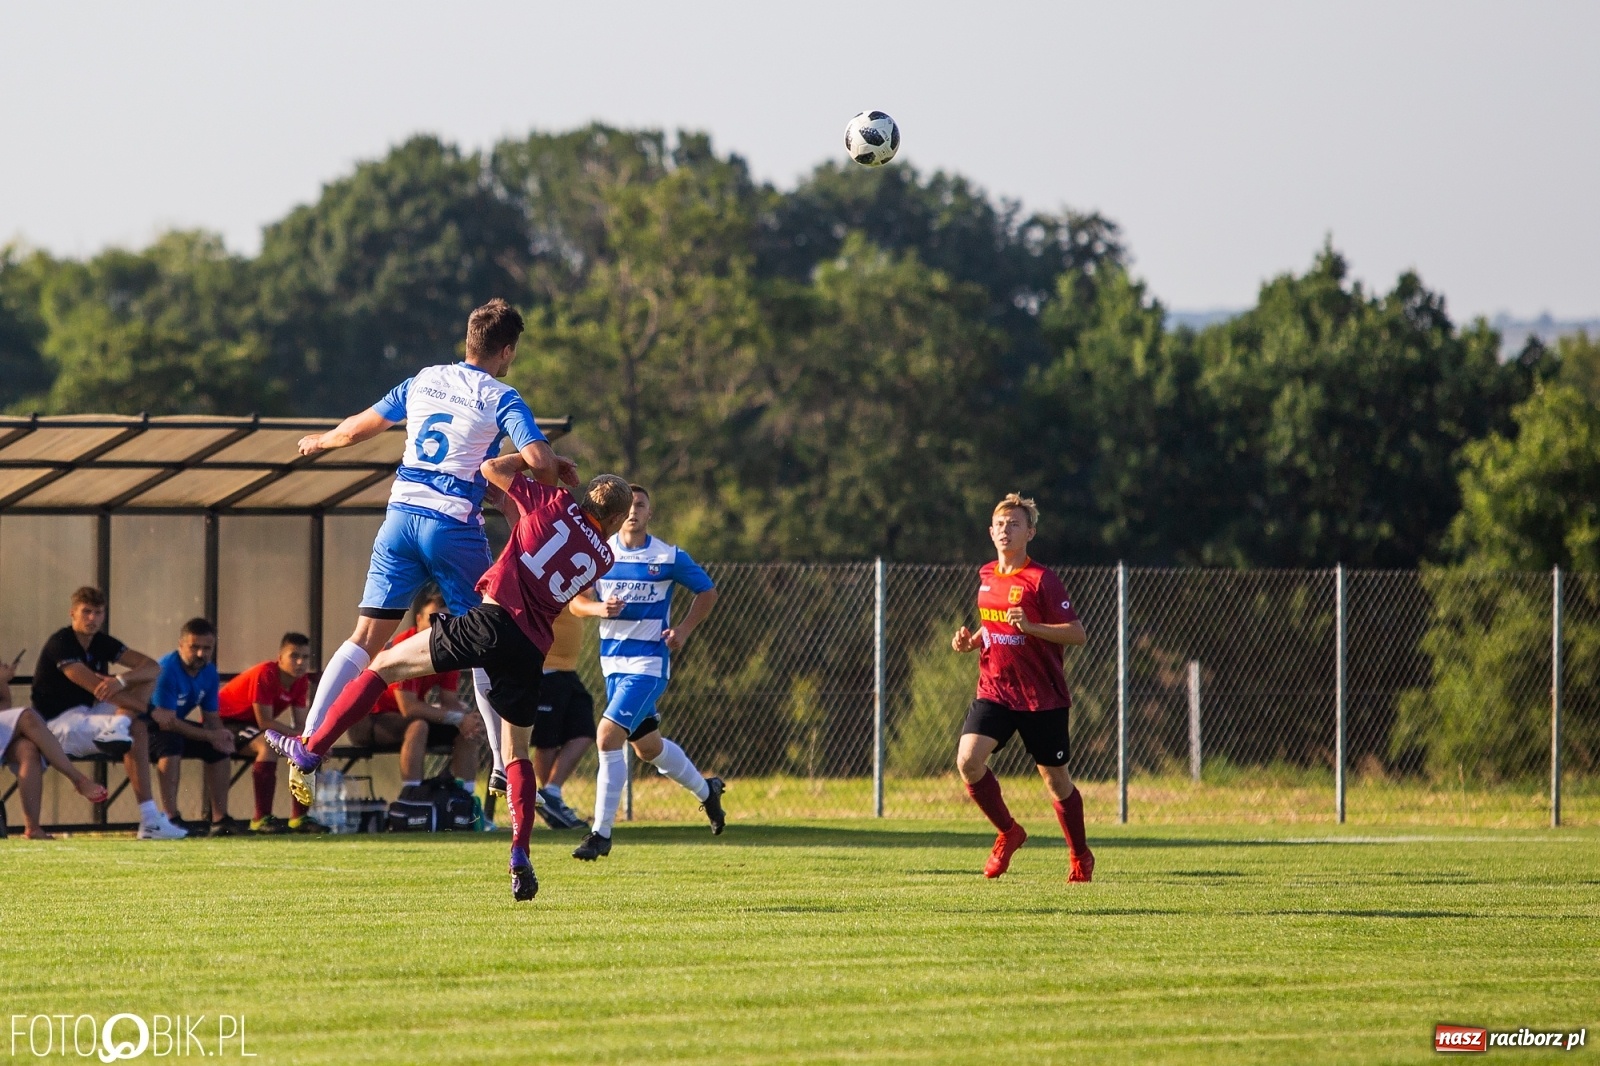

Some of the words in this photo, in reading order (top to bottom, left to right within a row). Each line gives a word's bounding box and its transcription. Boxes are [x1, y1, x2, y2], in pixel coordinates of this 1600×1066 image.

[449, 395, 485, 411] BORUCIN
[415, 413, 454, 465] 6
[520, 519, 597, 603] 13
[615, 582, 648, 590] SPORT
[991, 633, 1026, 645] TWIST
